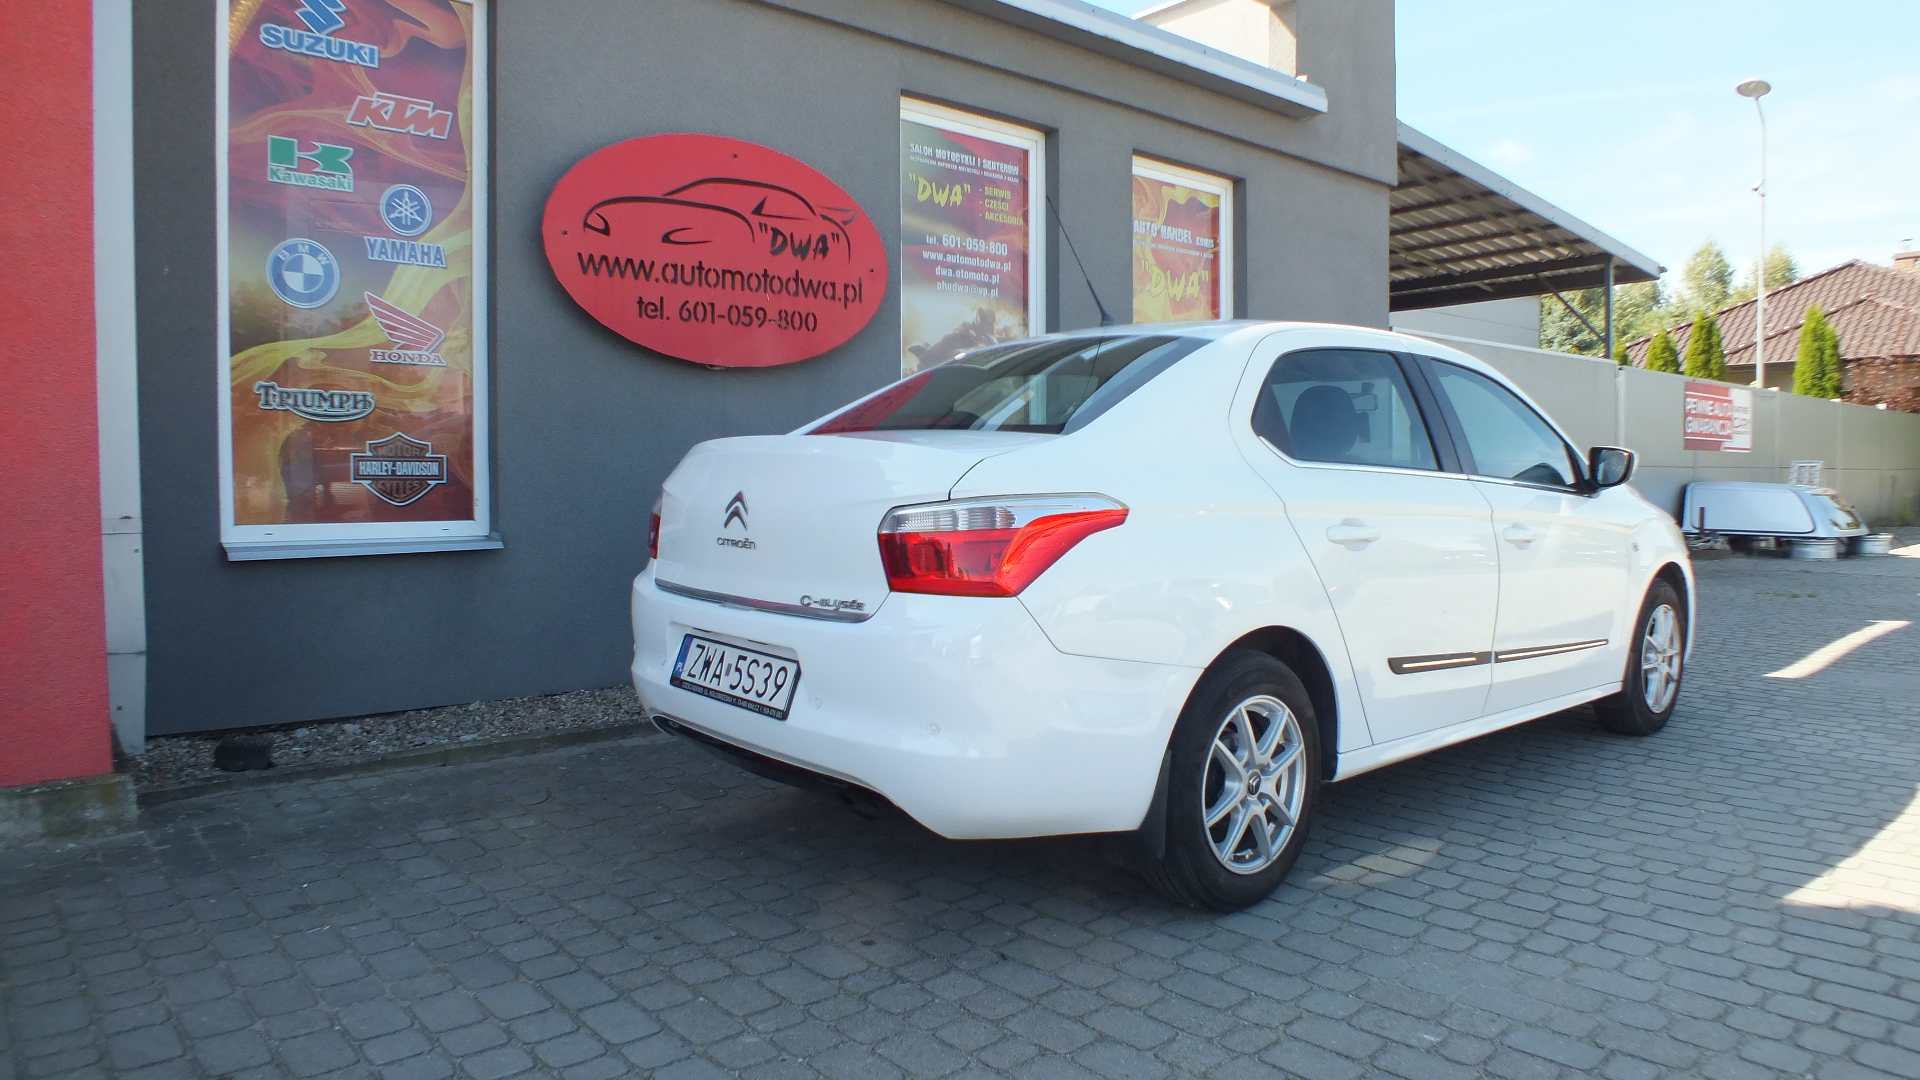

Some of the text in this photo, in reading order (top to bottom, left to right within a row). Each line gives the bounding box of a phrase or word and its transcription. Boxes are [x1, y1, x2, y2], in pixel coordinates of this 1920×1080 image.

[260, 24, 379, 68] SUZUKI
[347, 92, 453, 139] KTM
[909, 143, 933, 157] SALON
[935, 148, 976, 167] MOTOCYKLI
[983, 160, 1019, 176] SKUTERÓW
[268, 168, 353, 192] Kawasaki
[908, 172, 971, 208] "DWA"
[984, 186, 1012, 200] SERWIS
[984, 198, 1009, 212] CZĘŚCI
[985, 211, 1024, 227] AKCESORIA
[759, 221, 840, 261] "DWA"
[926, 233, 1008, 257] tel. 601-059-800
[1133, 219, 1158, 238] AUTO
[1160, 224, 1193, 245] HANDEL
[1195, 236, 1214, 249] KOMIS
[365, 236, 447, 269] YAMAHA
[922, 250, 1011, 272] www.automotodwa.pl
[577, 251, 864, 309] www.automotodwa.pl
[935, 265, 1000, 285] dwa.otomoto.pl
[937, 280, 998, 298] phudwa@vp.pl
[1140, 258, 1209, 302] "DWA"
[637, 295, 818, 333] tel. 601-059-800
[370, 349, 447, 366] HONDA
[254, 381, 376, 416] TRIUMPH
[359, 461, 439, 476] HARLEY-DAVIDSON
[686, 643, 789, 703] ZWA 5S39
